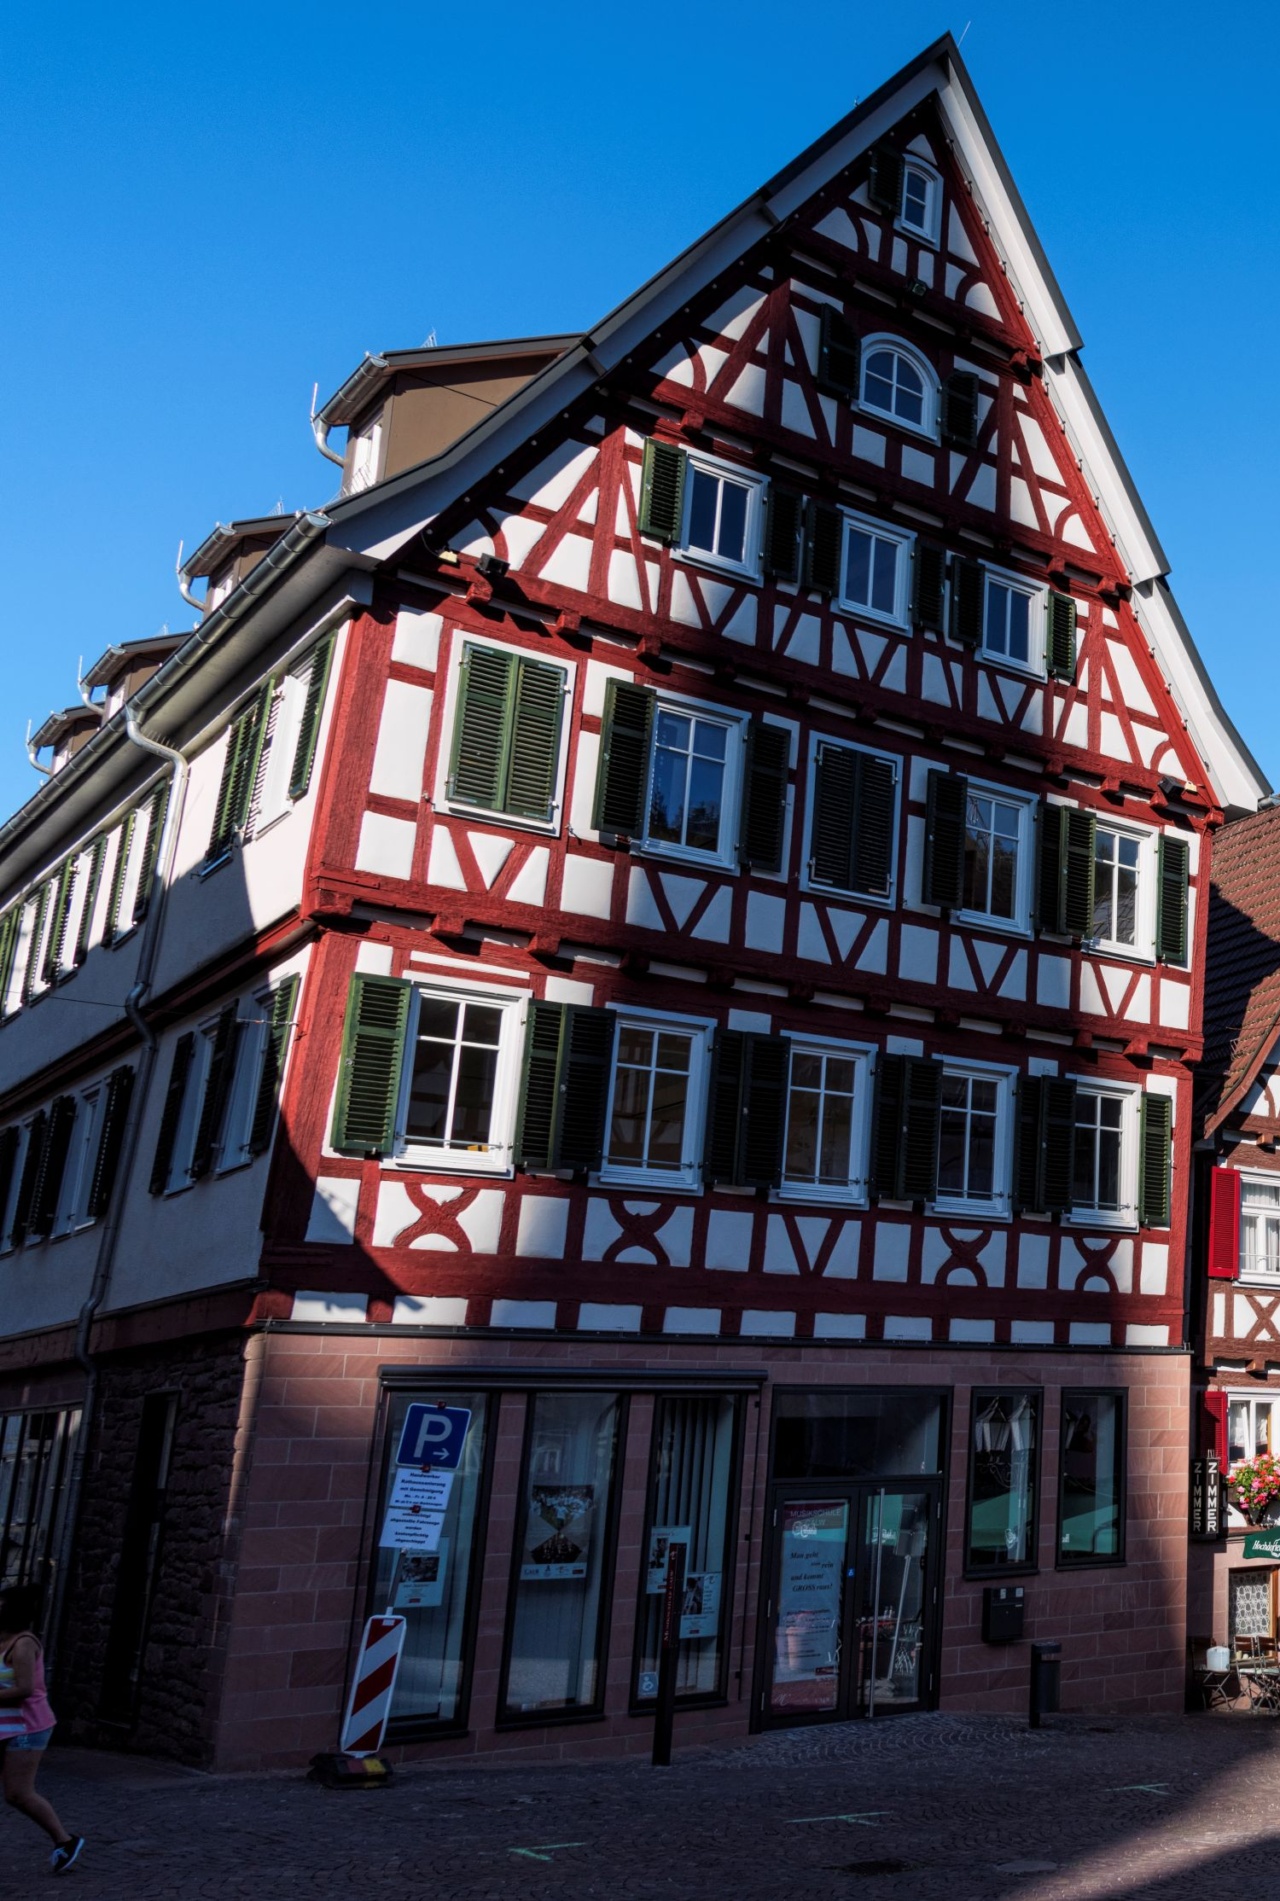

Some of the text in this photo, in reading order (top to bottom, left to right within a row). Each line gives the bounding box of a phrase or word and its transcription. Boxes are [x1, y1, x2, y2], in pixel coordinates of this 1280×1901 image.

[413, 1413, 453, 1458] P
[1193, 1462, 1202, 1532] ZIMMER
[1207, 1462, 1218, 1532] ZIMMER
